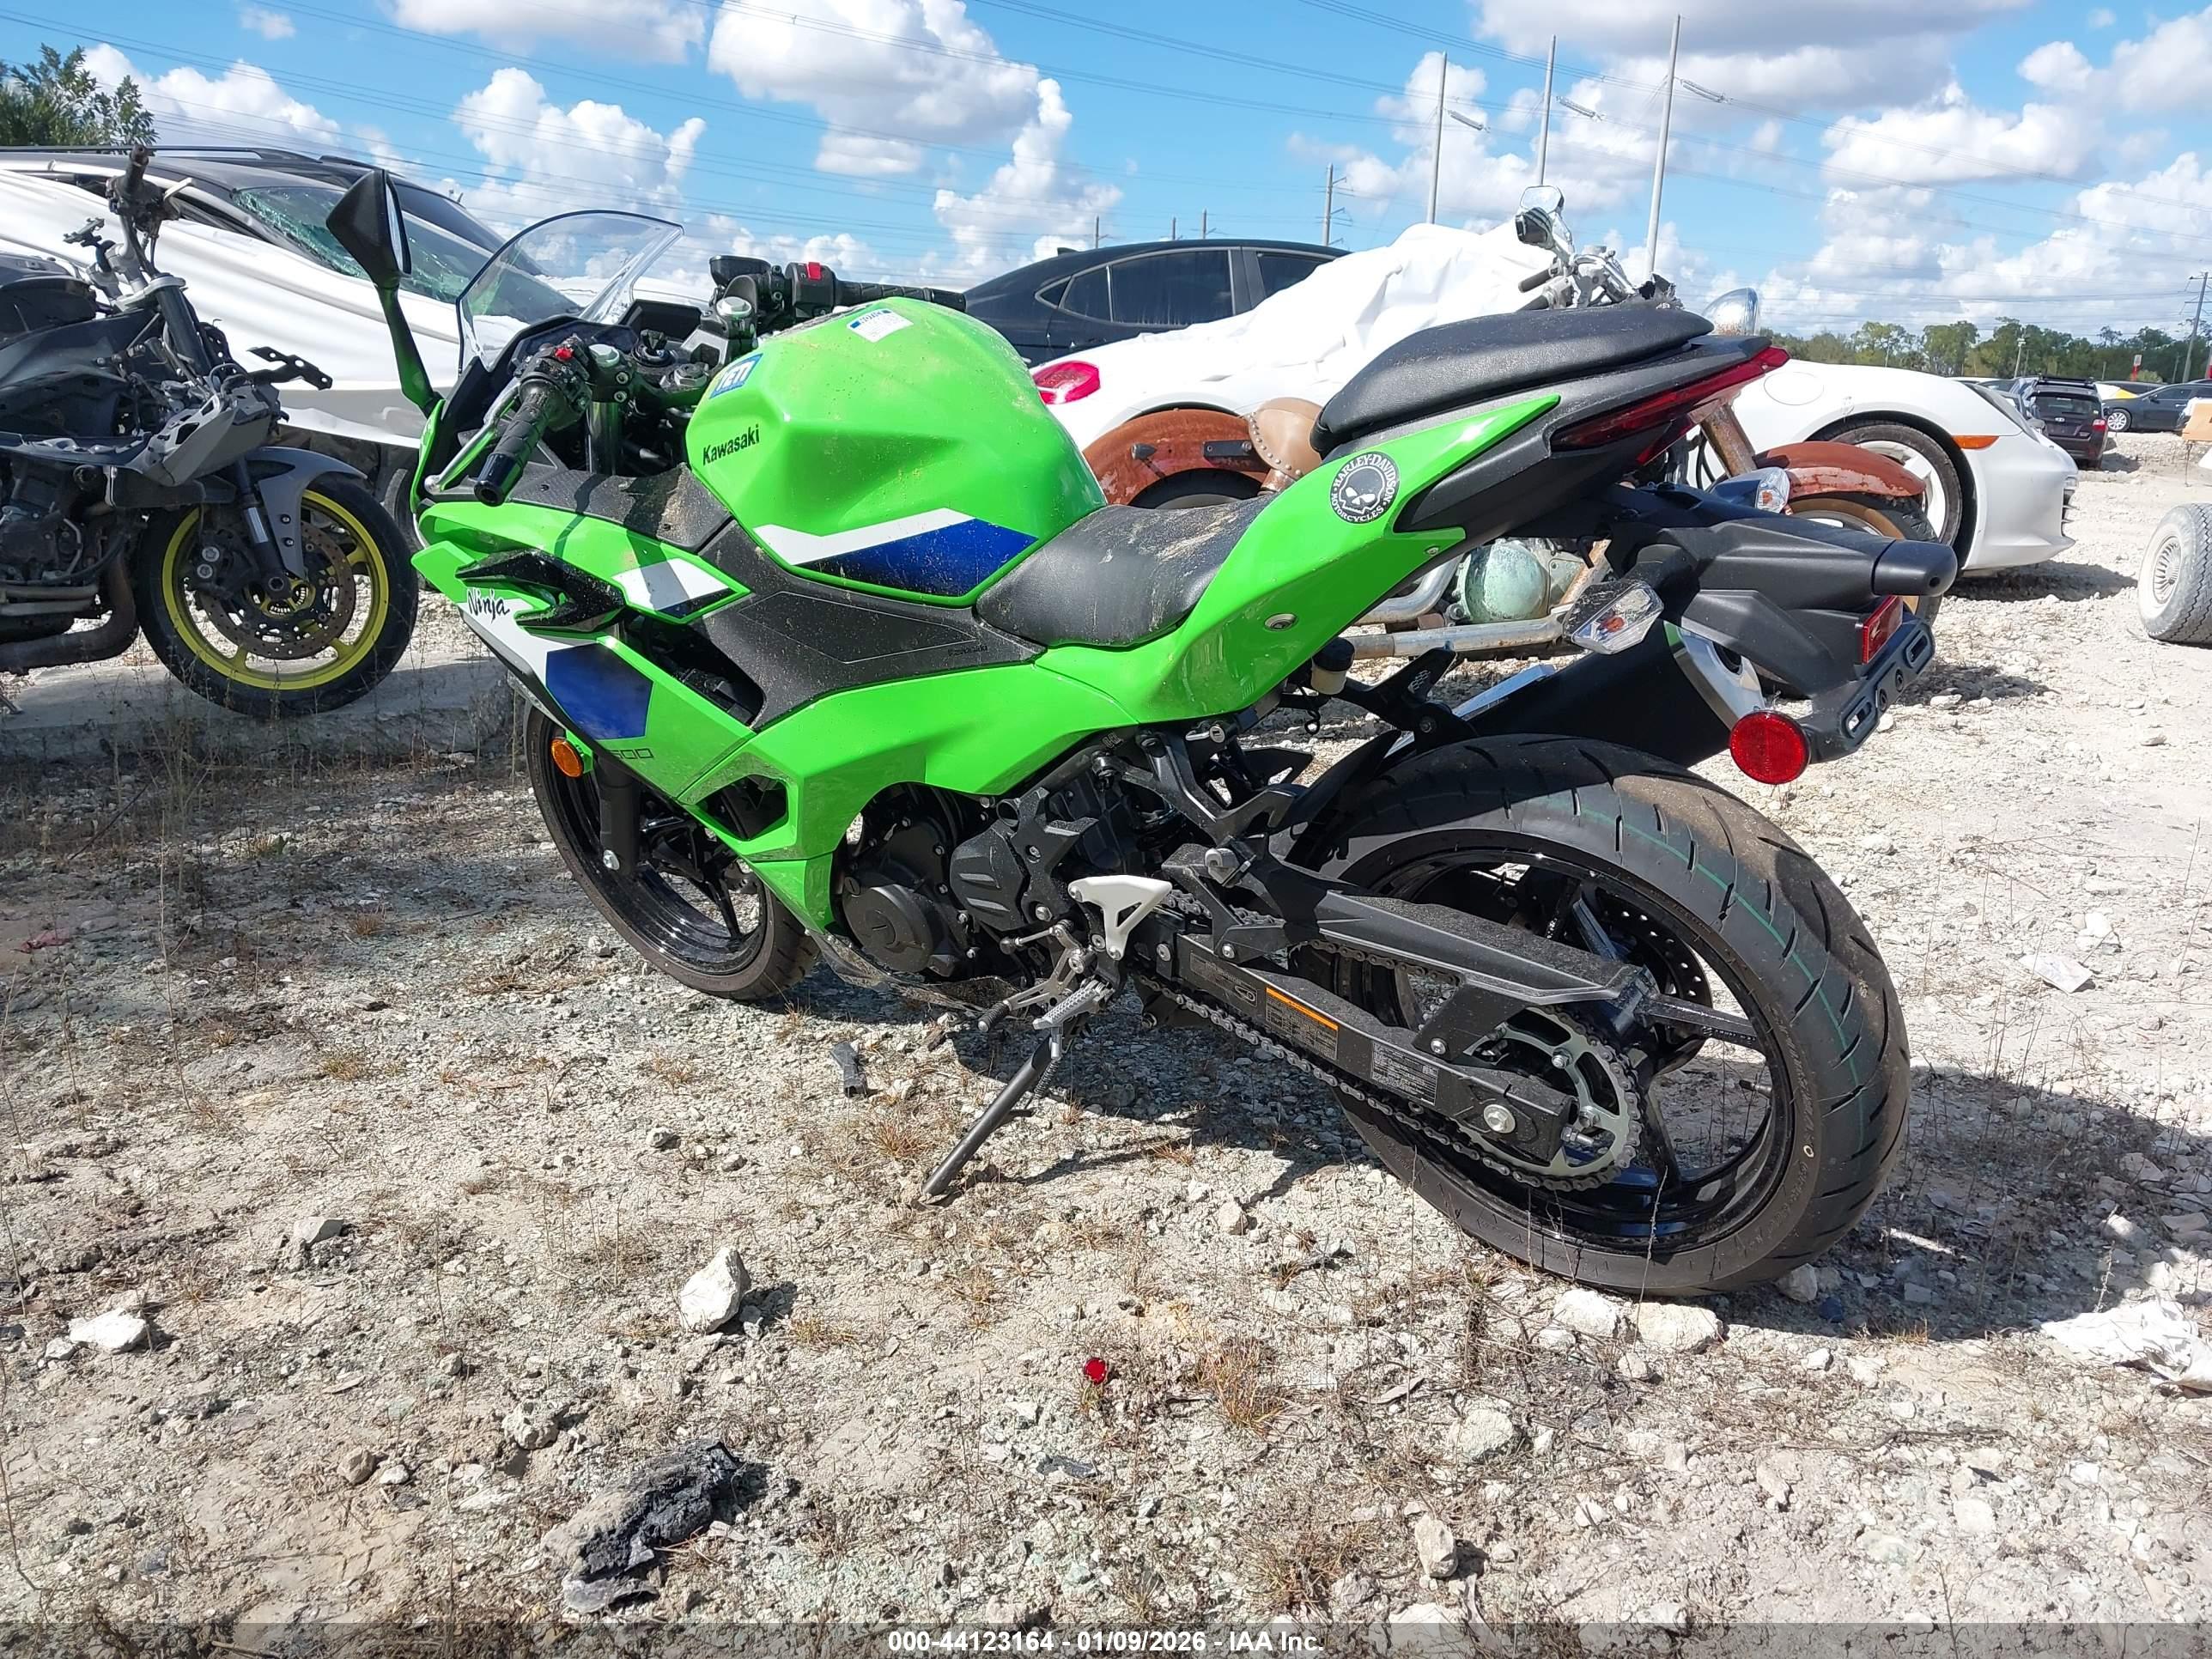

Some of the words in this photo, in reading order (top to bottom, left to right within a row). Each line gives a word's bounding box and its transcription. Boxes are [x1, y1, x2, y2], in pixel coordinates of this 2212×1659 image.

[714, 359, 757, 392] YETI
[702, 423, 760, 465] Kawasaki
[1333, 453, 1397, 505] HARLEY-DAVIDSON
[1331, 493, 1384, 523] MOTORCYCLES
[468, 588, 511, 624] Ninja
